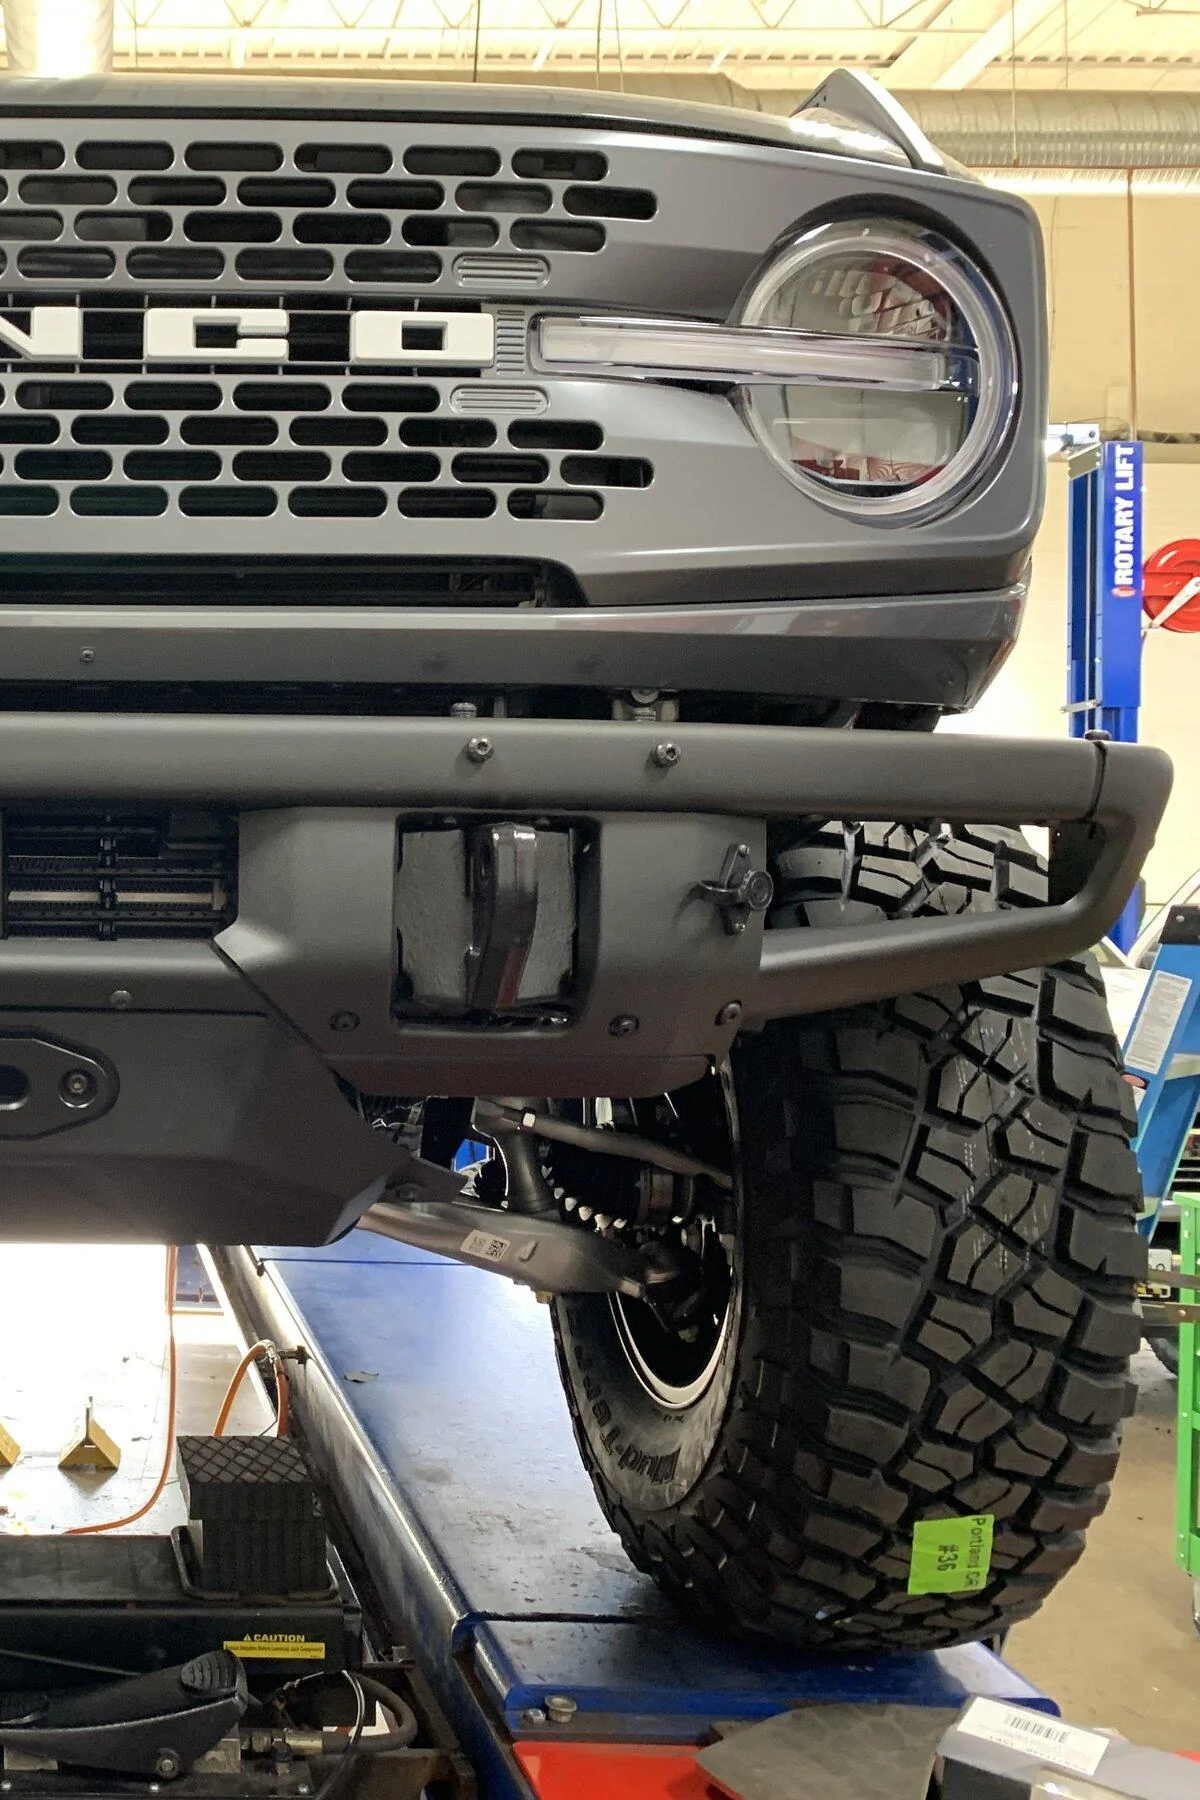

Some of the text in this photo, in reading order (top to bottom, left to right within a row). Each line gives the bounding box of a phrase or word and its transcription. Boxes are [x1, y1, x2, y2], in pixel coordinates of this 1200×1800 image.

[1114, 443, 1135, 586] ROTARY LIFT
[936, 1543, 960, 1572] #36
[253, 1633, 305, 1642] CAUTION
